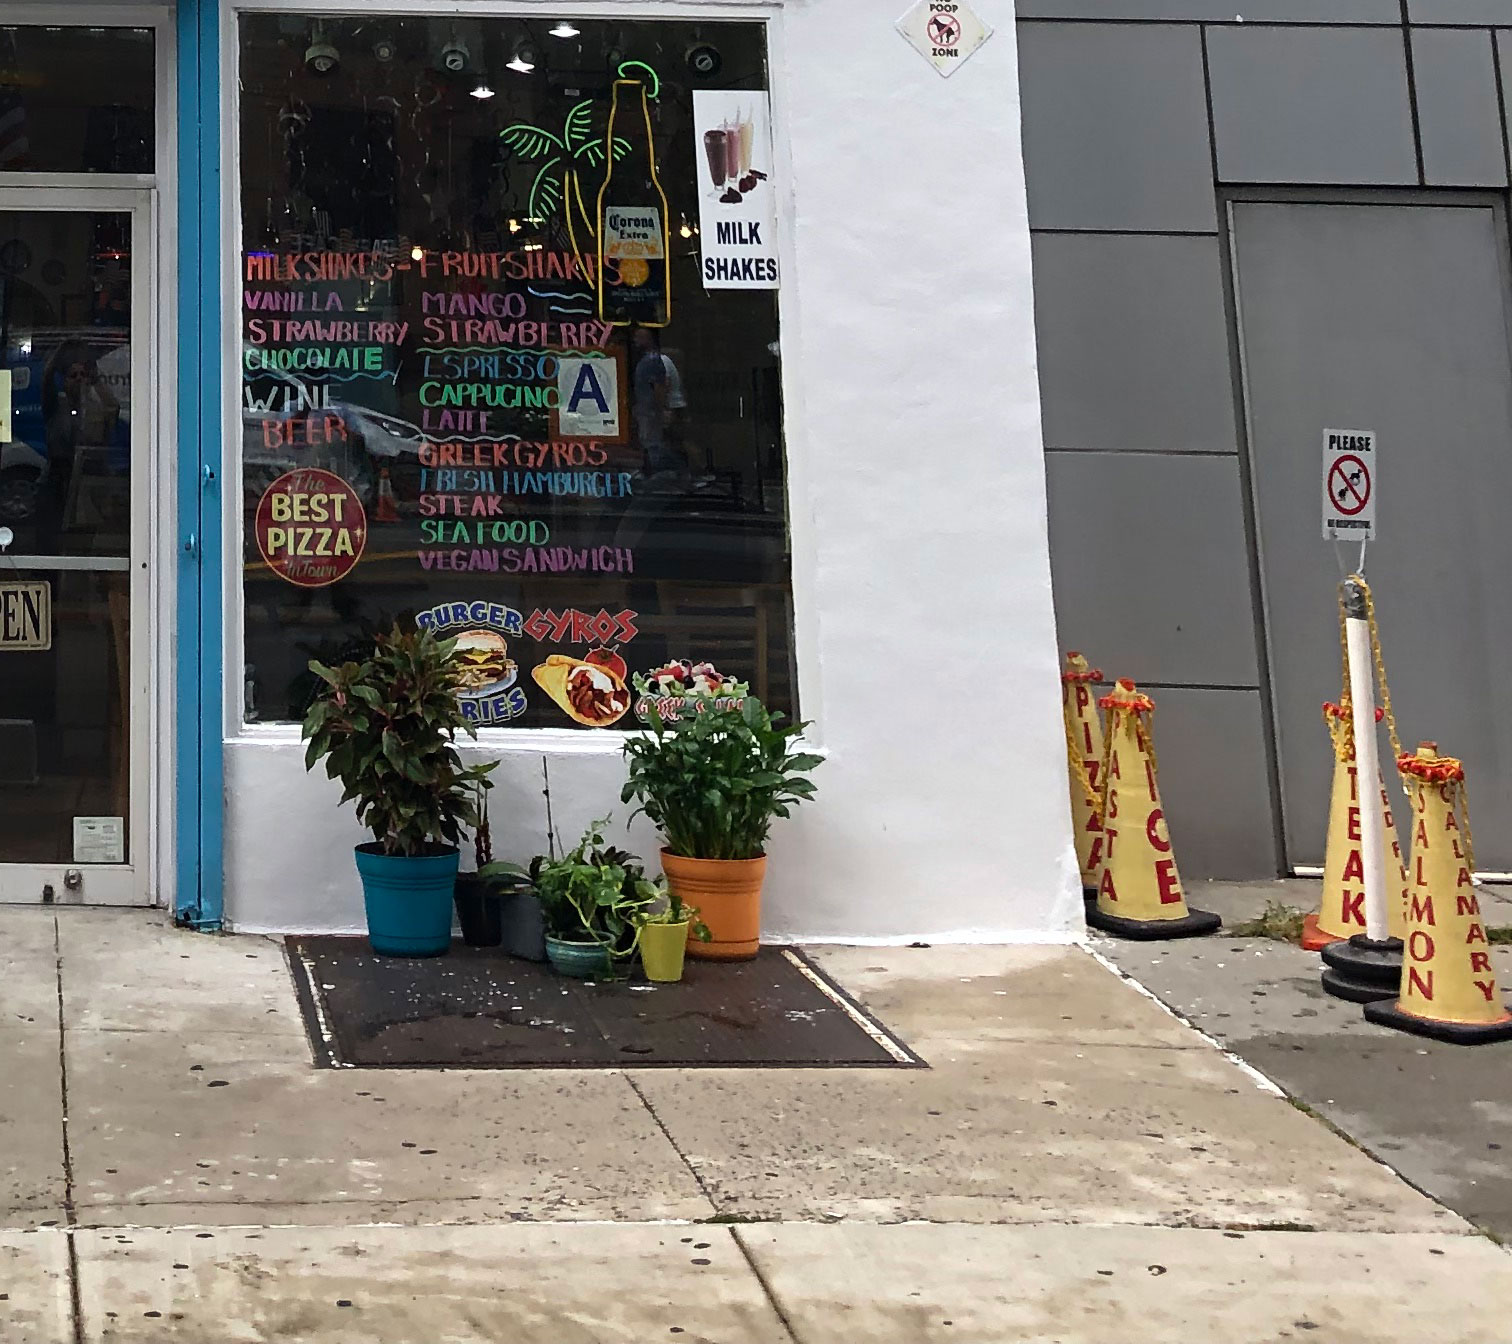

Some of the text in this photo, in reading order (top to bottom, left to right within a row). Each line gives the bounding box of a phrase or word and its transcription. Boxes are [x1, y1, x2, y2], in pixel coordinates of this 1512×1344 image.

[929, 4, 959, 13] POOP
[931, 47, 959, 58] ZONE
[608, 213, 655, 233] Corona
[618, 230, 649, 241] Extra
[716, 221, 762, 245] MILK
[704, 256, 778, 282] SHAKES
[244, 290, 343, 312] VANILLA
[421, 291, 527, 318] MANGO
[248, 318, 409, 346] STRAWBERRY
[422, 316, 614, 349] STRAWBERRY
[245, 346, 384, 371] CHOCOLATE
[422, 354, 561, 381] ESPRESSO
[244, 384, 342, 413] WINE
[418, 381, 562, 409] CAPPUCINO
[567, 363, 610, 413] A
[262, 415, 348, 449] BEER
[422, 408, 491, 433] LATTE
[417, 440, 609, 469] GREEK GYROS
[1328, 434, 1372, 452] PLEASE
[290, 473, 326, 491] The
[419, 468, 634, 498] FRESH HAMBURGER
[271, 493, 348, 523] BEST
[418, 494, 504, 518] STEAK
[267, 526, 355, 557] PIZZA
[415, 600, 524, 639] BURGER
[522, 607, 640, 644] GYROS
[457, 687, 528, 725] RIES
[635, 696, 686, 723] GEEK
[1341, 739, 1367, 927] TEAK
[1407, 783, 1437, 1001] SALMON
[1439, 783, 1496, 1002] CALAMARY
